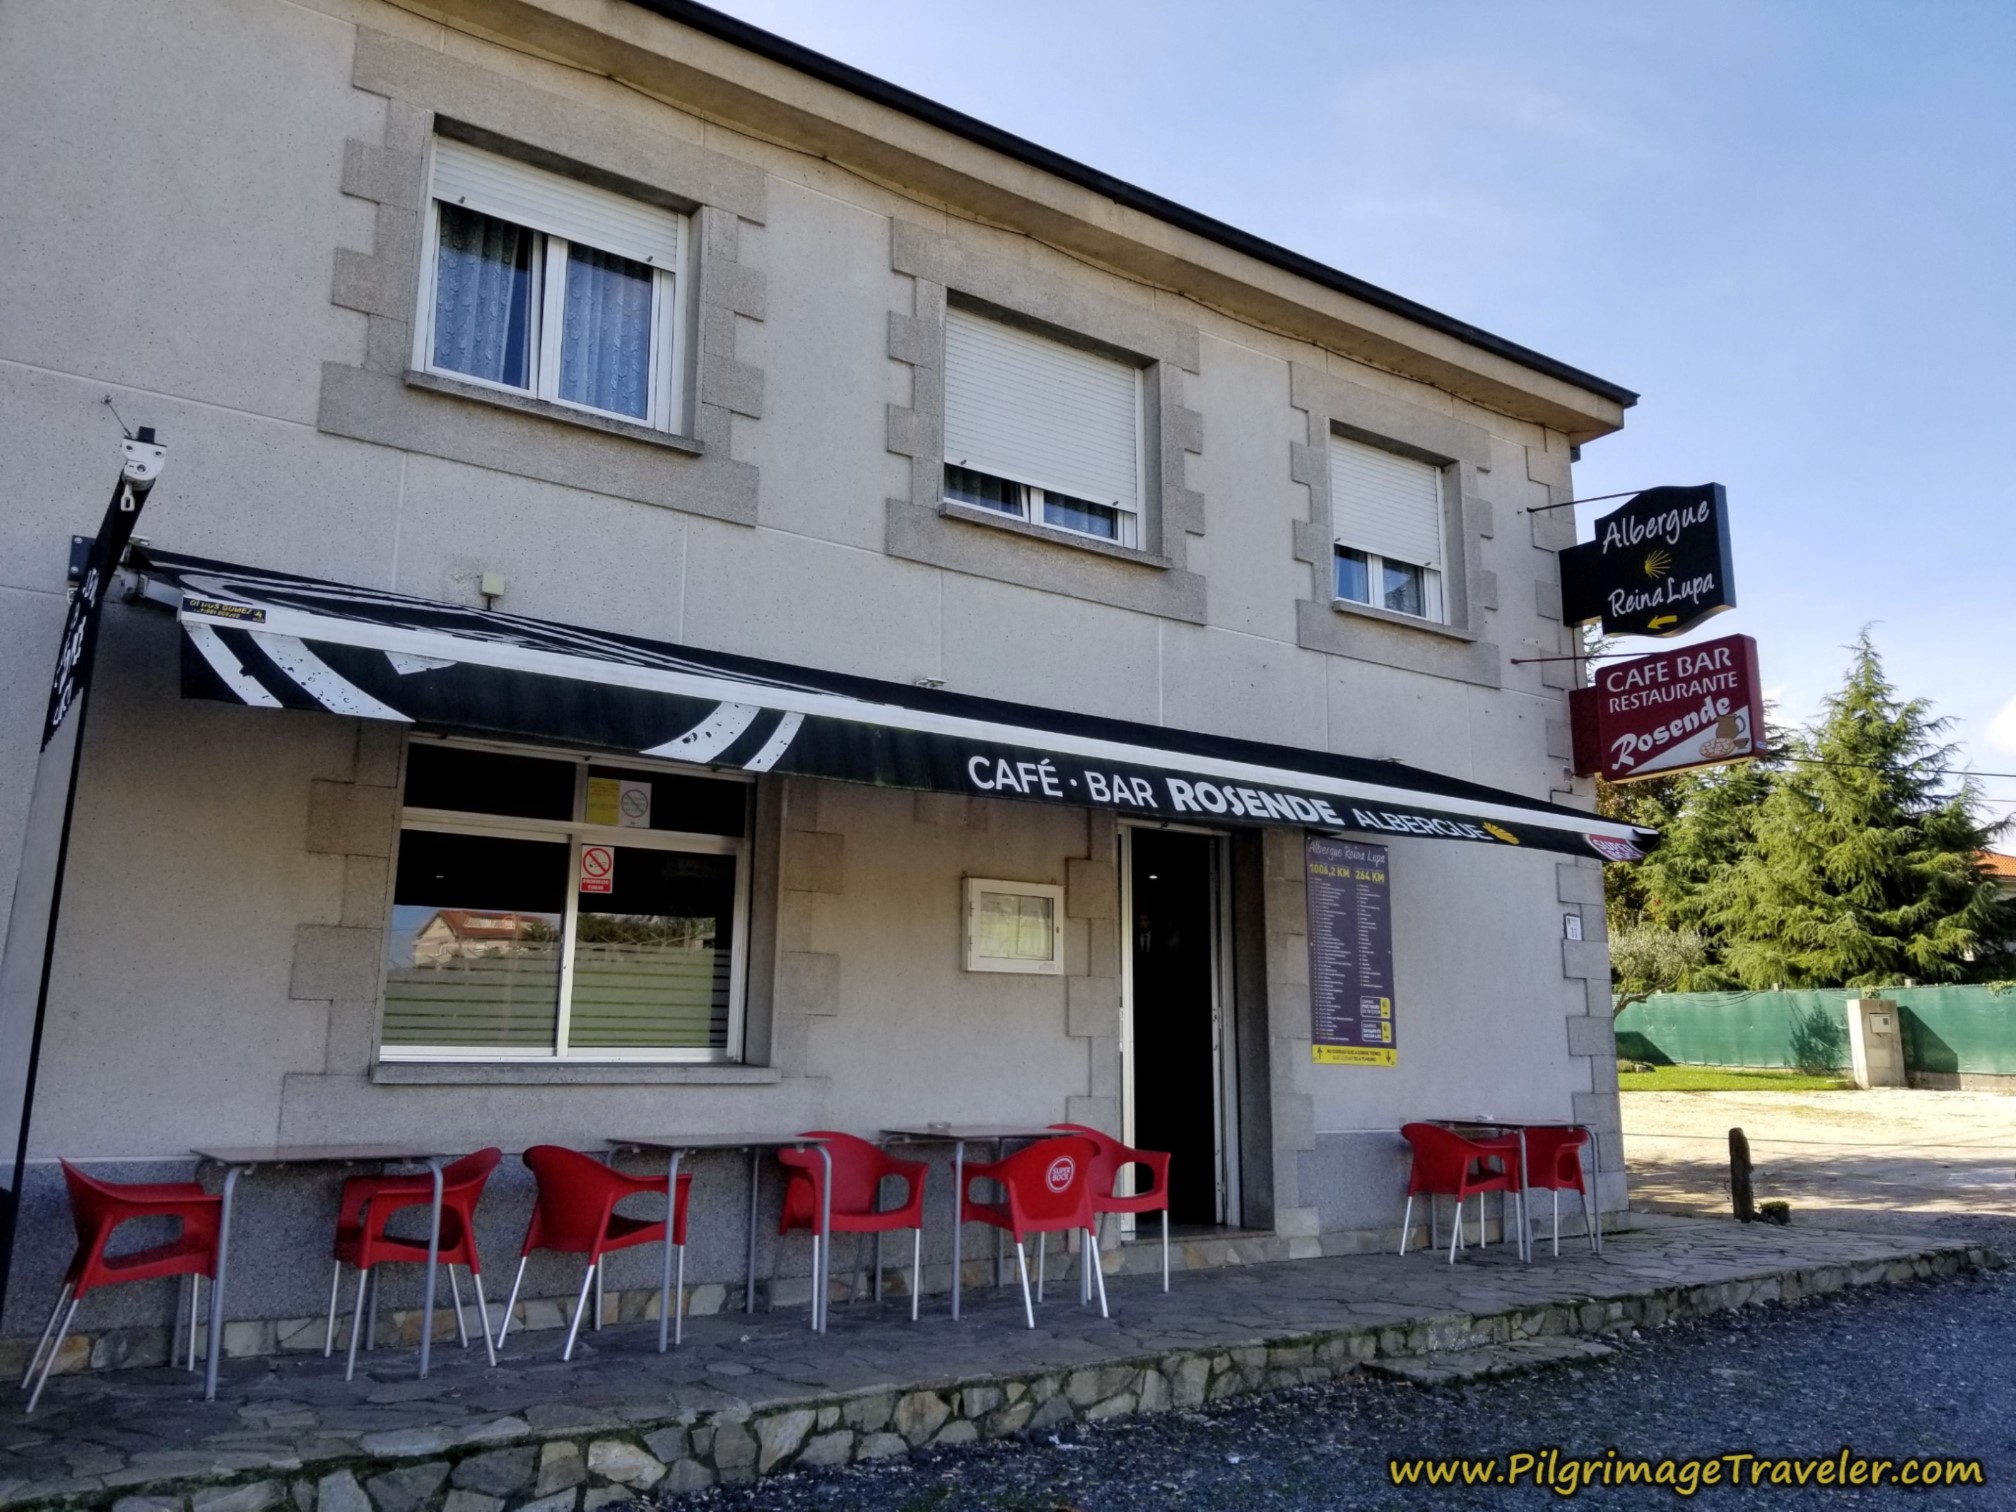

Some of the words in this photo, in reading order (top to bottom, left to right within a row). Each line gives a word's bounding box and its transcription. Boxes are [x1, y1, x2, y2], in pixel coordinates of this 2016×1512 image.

[1602, 500, 1710, 555] Albergue
[1608, 587, 1663, 618] Reina
[1666, 572, 1715, 605] Lupa
[1606, 661, 1670, 693] CAFE
[1676, 647, 1733, 678] BAR
[1609, 671, 1739, 714] RESTAURANTE
[1610, 695, 1731, 771] Rosende
[967, 754, 1064, 798] CAFÉ
[1084, 770, 1159, 809] BAR
[1165, 777, 1345, 826] ROSENDE
[1351, 808, 1495, 841] ALBERGUE
[1309, 840, 1342, 861] Albergue
[1337, 867, 1350, 878] KM
[1355, 870, 1370, 881] 264
[1371, 871, 1385, 883] KM
